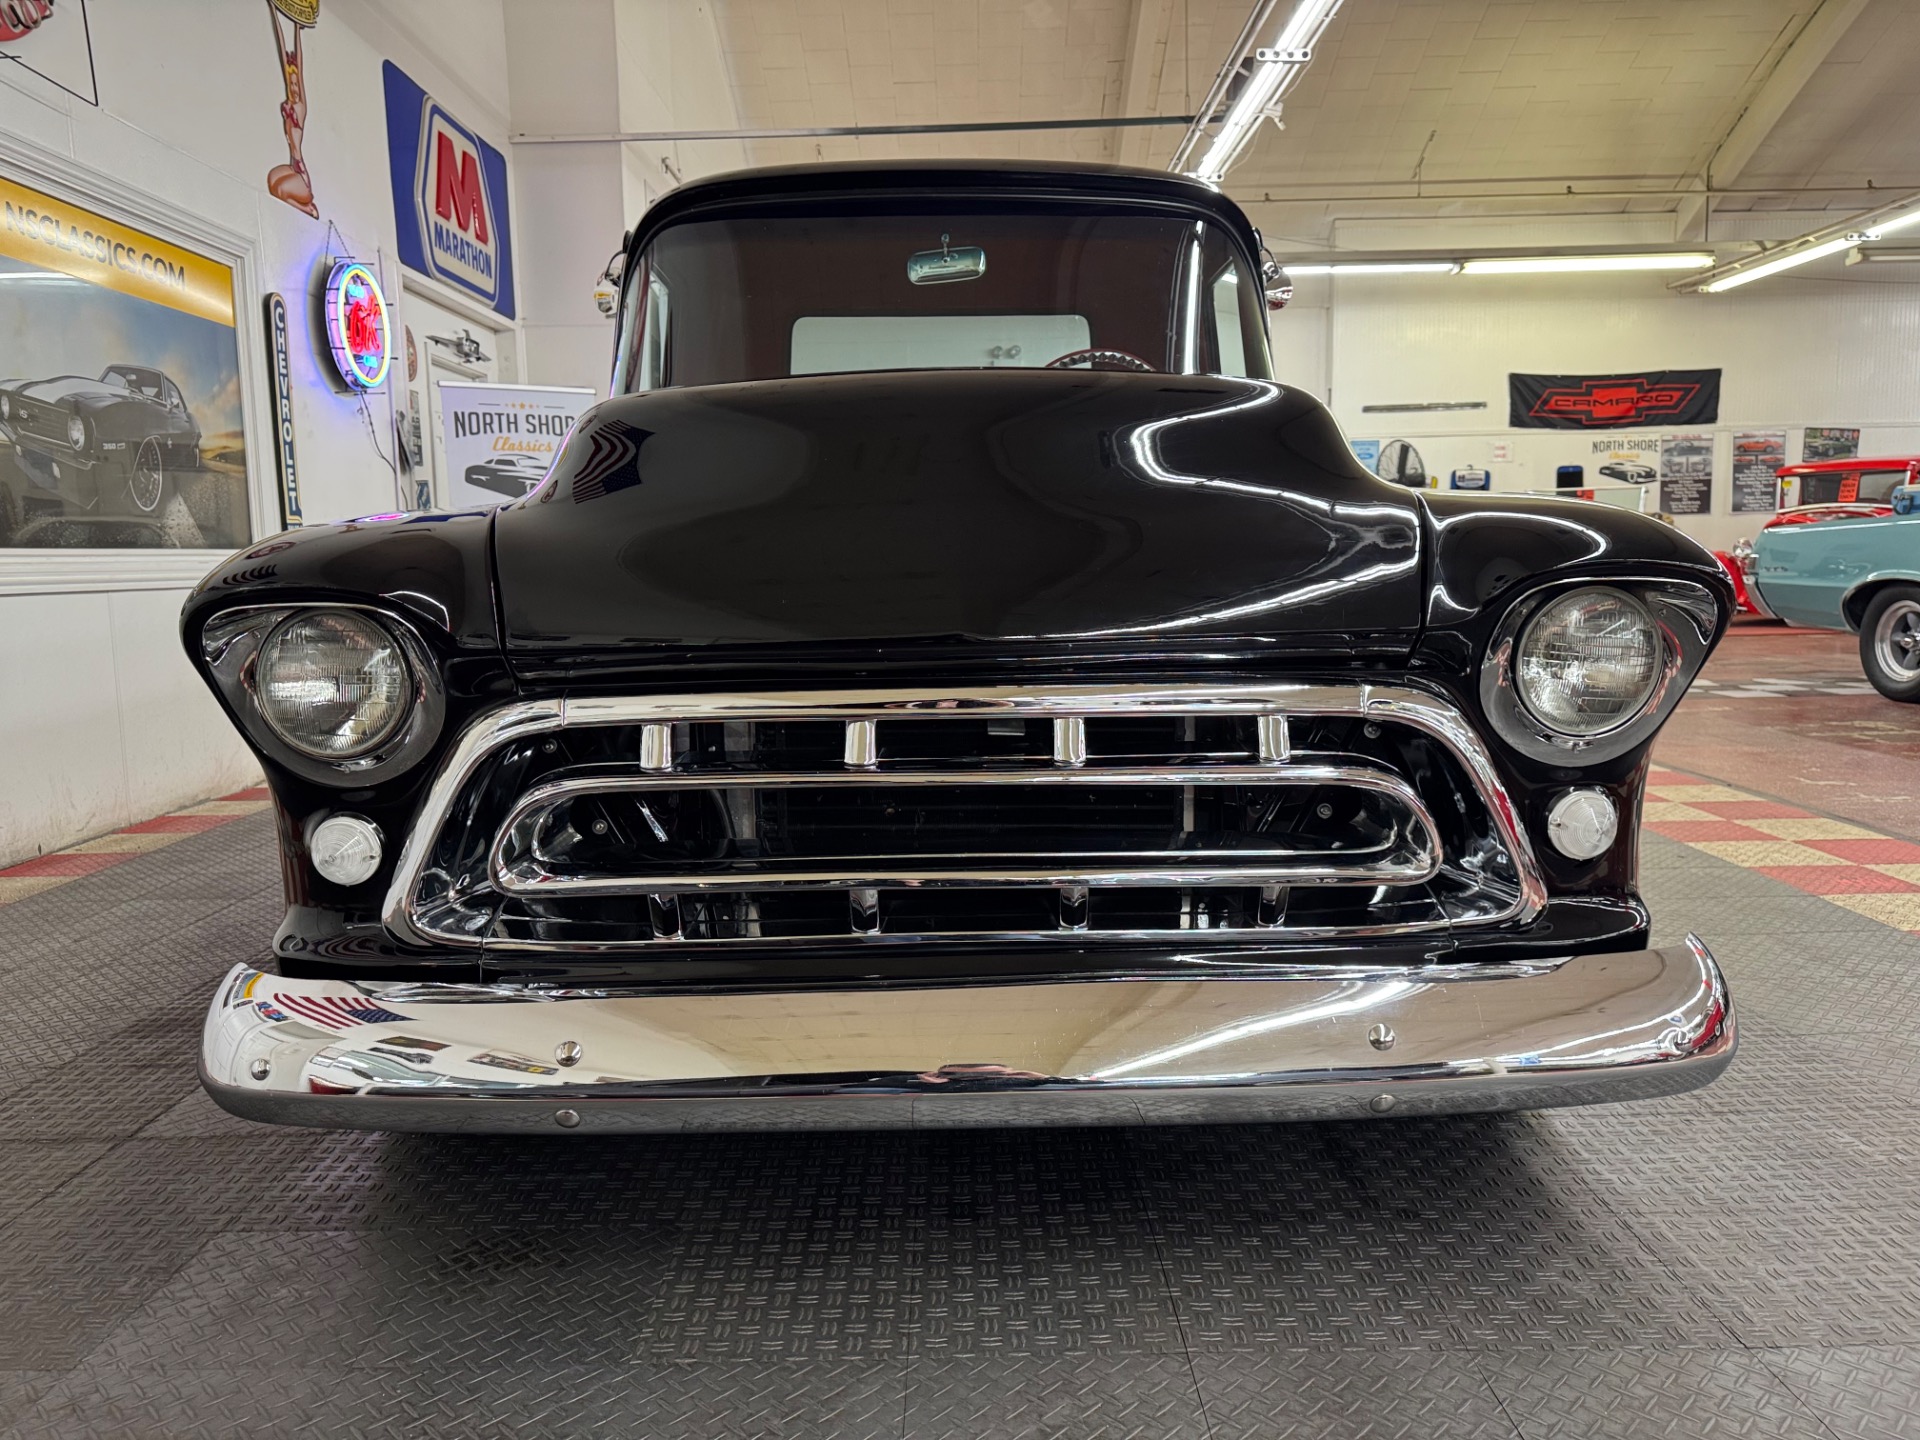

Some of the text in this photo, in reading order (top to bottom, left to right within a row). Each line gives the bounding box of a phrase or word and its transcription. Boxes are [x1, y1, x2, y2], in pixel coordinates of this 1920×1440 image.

[436, 130, 489, 246] M
[5, 201, 186, 290] NSCLASSICS.COM
[434, 221, 493, 279] MARATHON
[275, 307, 297, 511] CHEVROLET
[1554, 394, 1673, 408] CAMARO
[453, 410, 519, 438] NORTH
[492, 436, 553, 452] Classics
[1592, 439, 1659, 454] NORTH SHORE
